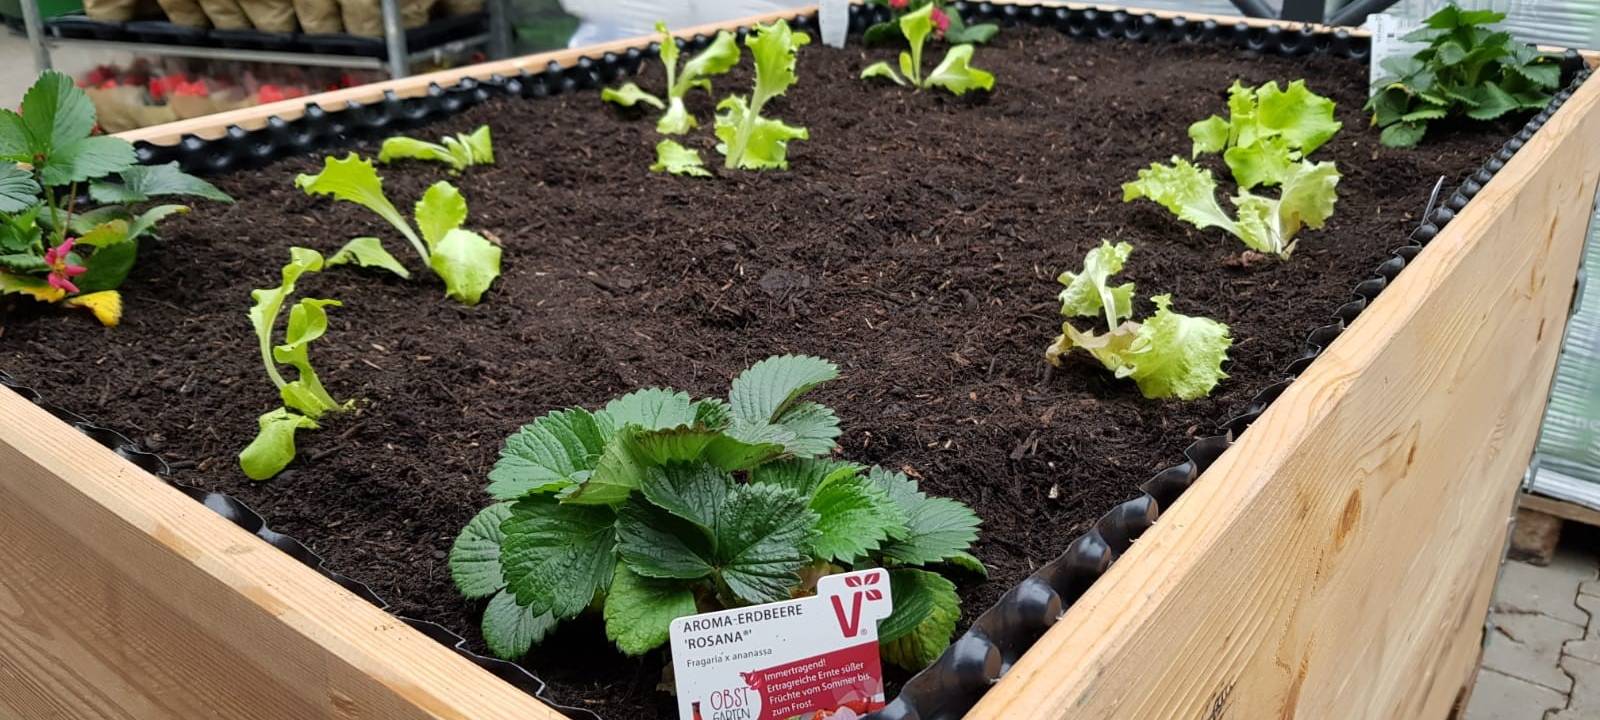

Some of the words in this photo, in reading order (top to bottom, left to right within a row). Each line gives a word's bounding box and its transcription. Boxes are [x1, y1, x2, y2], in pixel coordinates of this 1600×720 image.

[683, 604, 803, 633] AROMA-ERDBEERE
[686, 655, 723, 668] Fragaria
[732, 648, 773, 660] ananassa
[764, 658, 826, 681] Immertragend!
[767, 674, 817, 693] Ertragreiche
[818, 669, 840, 680] Ernte
[841, 662, 865, 674] süßer
[769, 690, 801, 705] Früchte
[802, 686, 821, 696] vom
[821, 676, 857, 691] Sommer
[857, 673, 870, 681] bis
[710, 686, 749, 711] OBST
[772, 707, 791, 717] zum
[791, 699, 815, 712] Frost.
